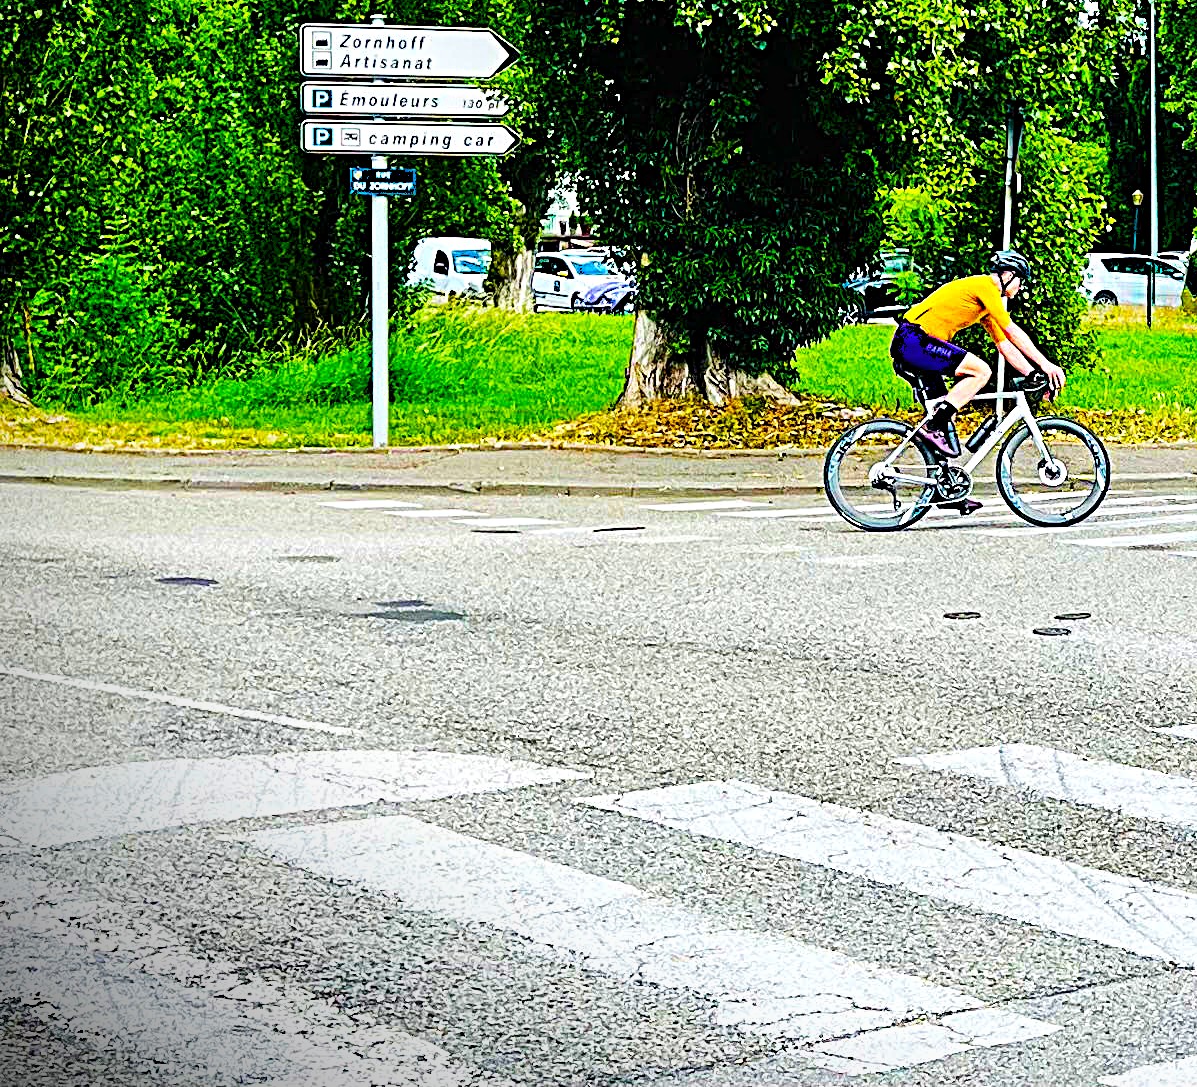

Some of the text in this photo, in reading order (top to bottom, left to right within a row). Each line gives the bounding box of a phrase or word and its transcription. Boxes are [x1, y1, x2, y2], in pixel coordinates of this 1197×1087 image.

[340, 34, 427, 50] Zornhoff
[340, 54, 432, 69] Artisanat
[340, 90, 439, 108] Émouleurs
[369, 132, 452, 149] camping
[463, 134, 494, 147] car
